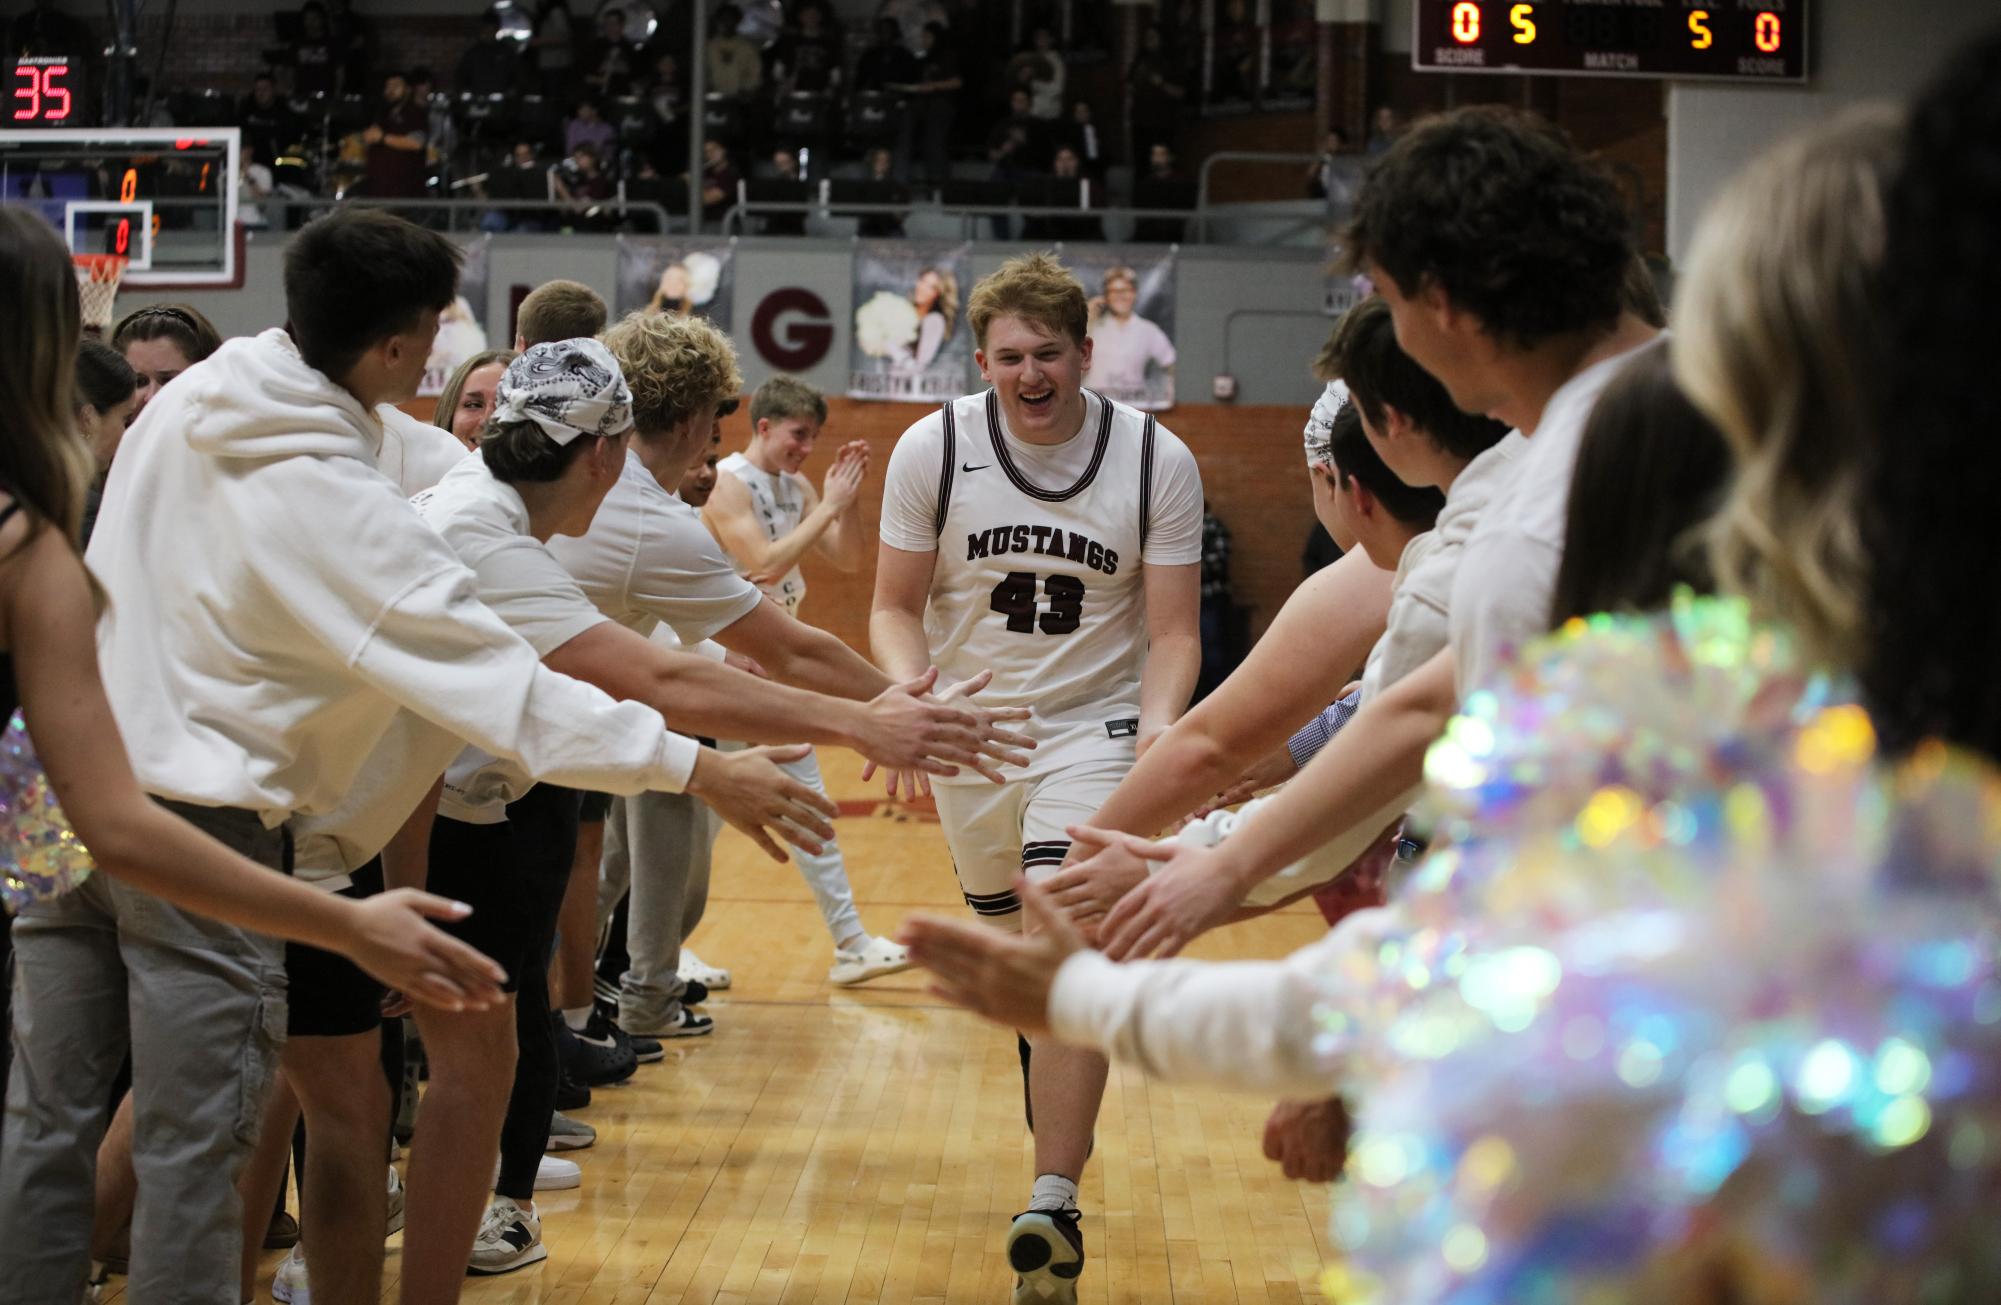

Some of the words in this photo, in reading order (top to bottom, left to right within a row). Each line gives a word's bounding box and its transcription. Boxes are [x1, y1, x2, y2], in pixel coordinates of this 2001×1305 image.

[1452, 1, 1480, 44] 0
[1509, 3, 1537, 44] 5
[1687, 10, 1713, 49] 5
[1754, 12, 1781, 52] 0
[1435, 48, 1484, 65] SCORE
[1583, 52, 1639, 70] MATCH
[1738, 57, 1786, 75] SCORE
[14, 66, 71, 119] 35
[750, 286, 834, 372] G
[966, 524, 1119, 576] MUSTANGS
[990, 571, 1086, 635] 43
